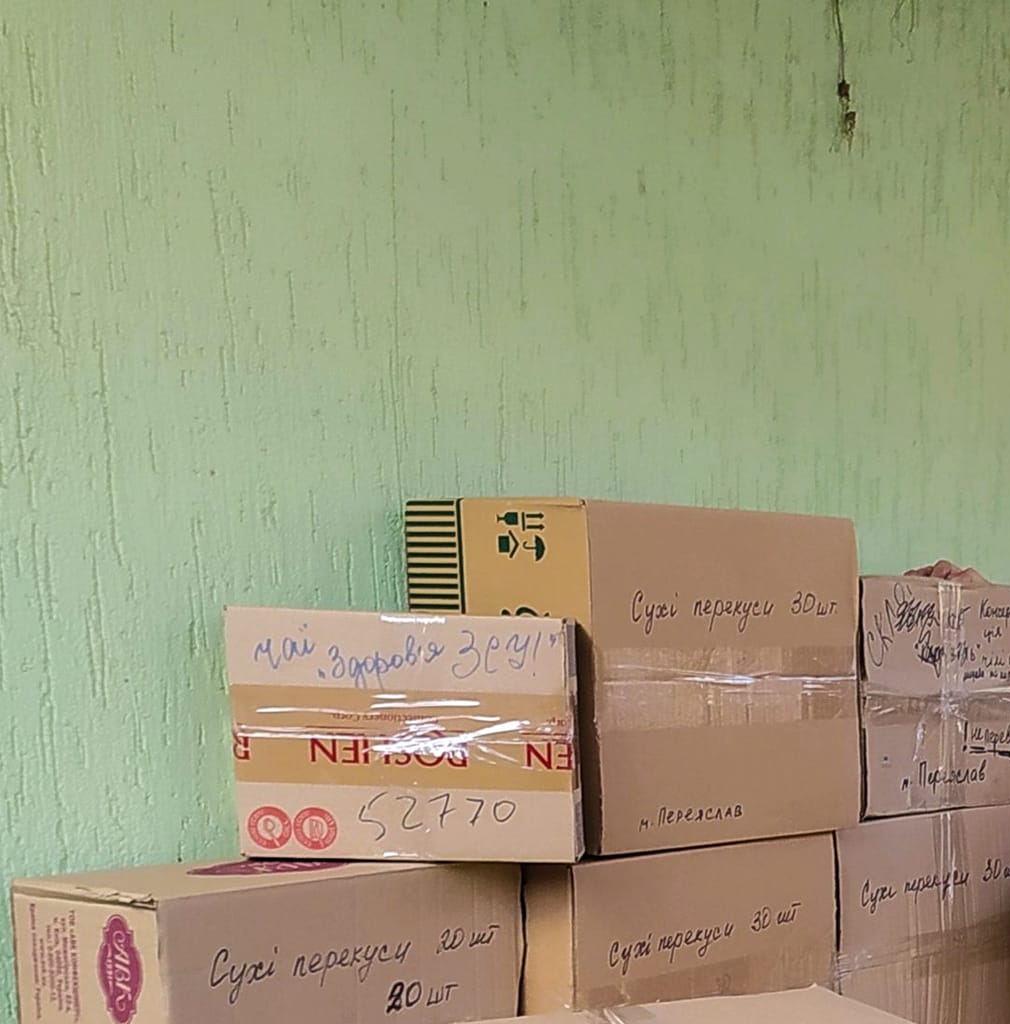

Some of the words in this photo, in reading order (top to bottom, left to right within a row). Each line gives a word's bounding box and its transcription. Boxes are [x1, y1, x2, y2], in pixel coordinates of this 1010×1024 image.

[630, 589, 679, 635] Сухі
[693, 597, 777, 634] перекуси
[358, 791, 517, 841] 52770
[209, 946, 279, 1006] Сухі
[292, 941, 412, 988] перекуси
[609, 935, 652, 976] Сухі
[656, 923, 735, 965] перекуси
